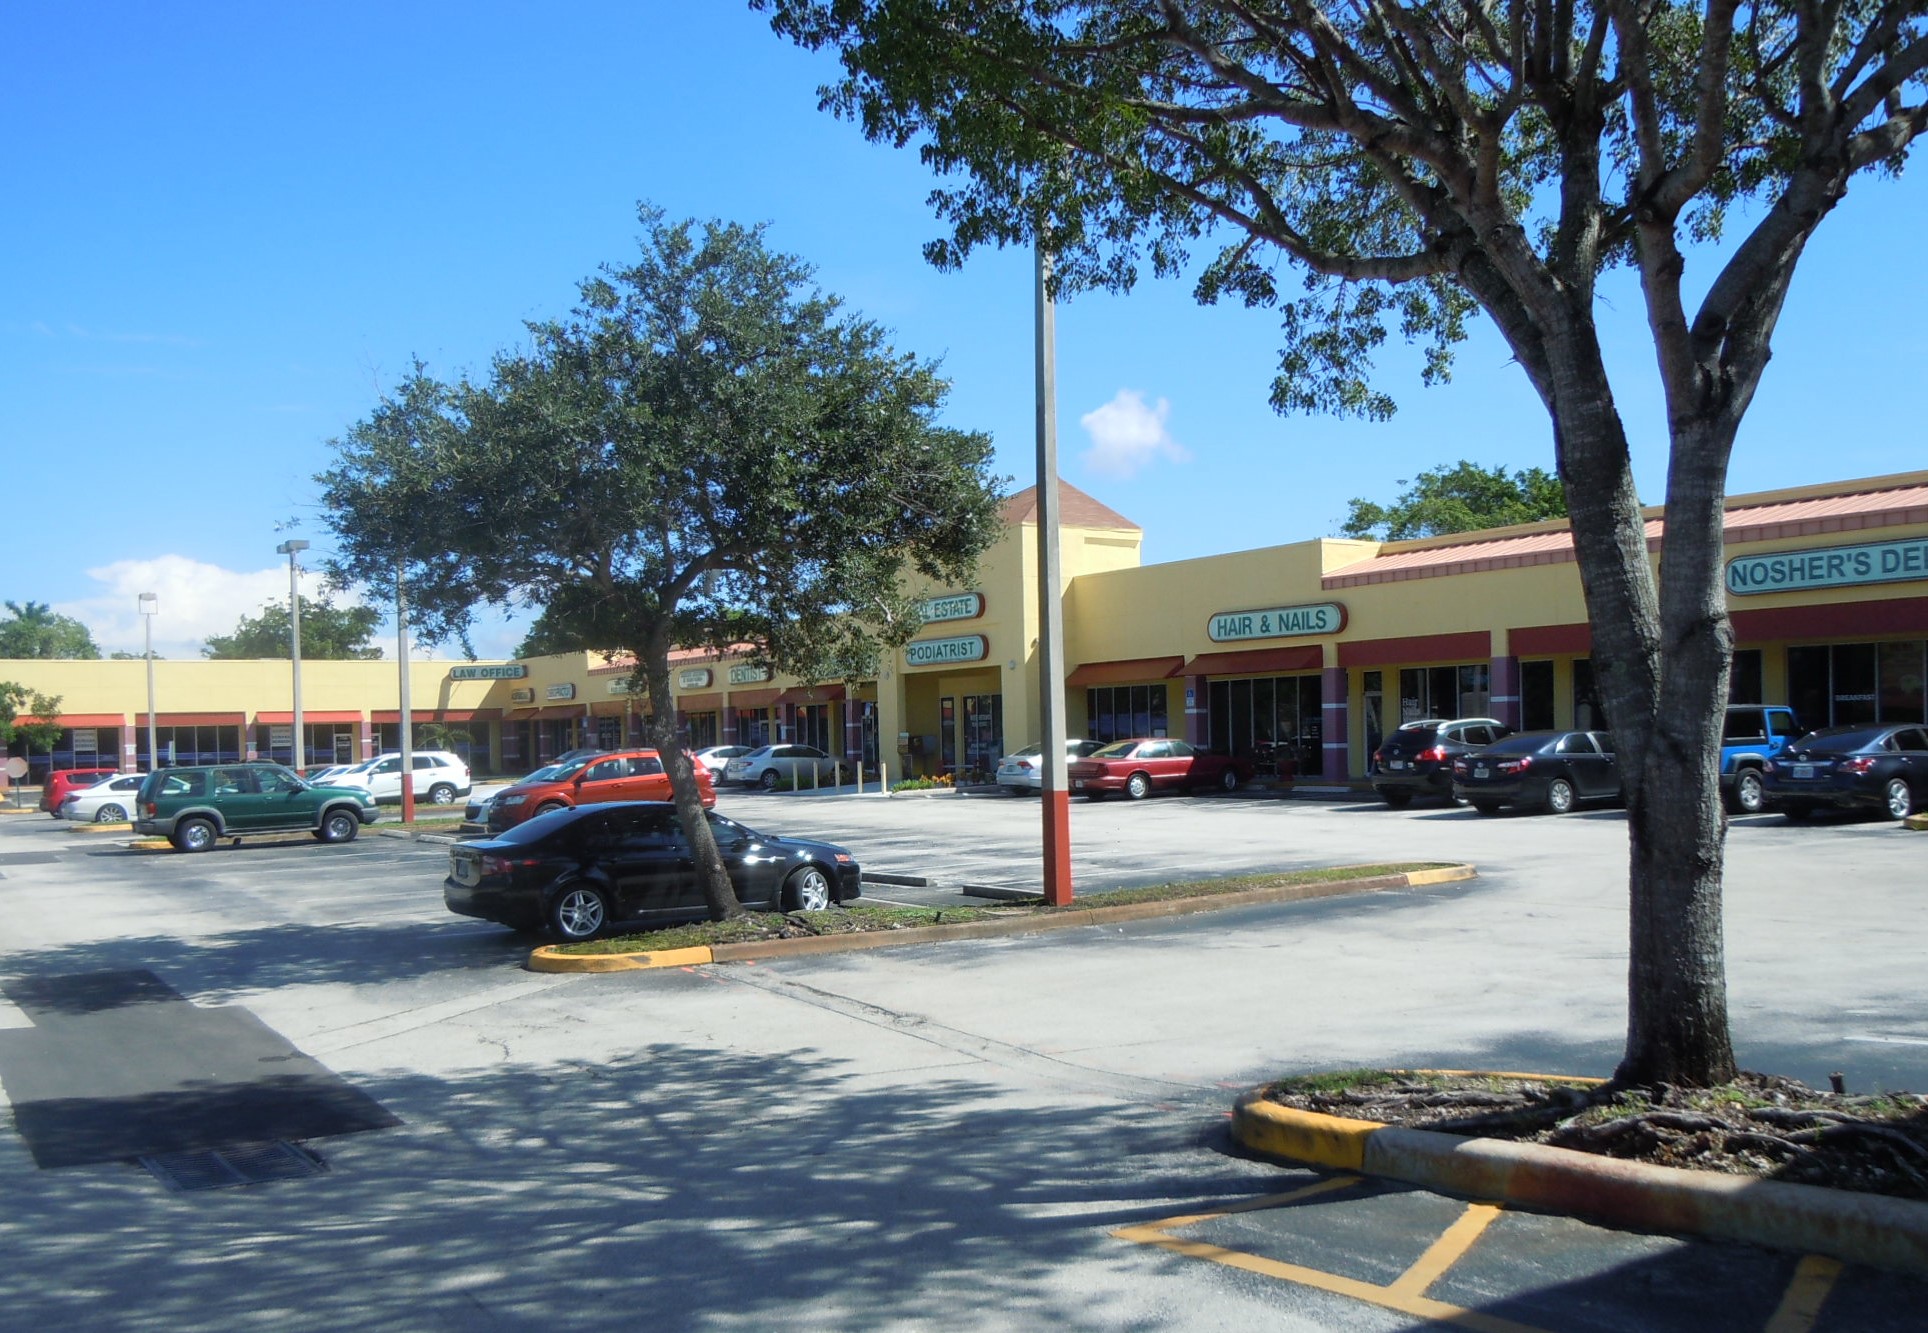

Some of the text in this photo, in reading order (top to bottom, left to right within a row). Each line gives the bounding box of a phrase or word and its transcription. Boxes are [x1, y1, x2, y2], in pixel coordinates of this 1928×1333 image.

[1731, 552, 1871, 587] NOSHER'S
[934, 598, 972, 618] ESTATE
[1217, 609, 1327, 637] HAIR & NAILS
[910, 641, 975, 661] PODIATRIST
[453, 667, 520, 678] LAW OFFICE
[730, 666, 762, 682] DENTIST
